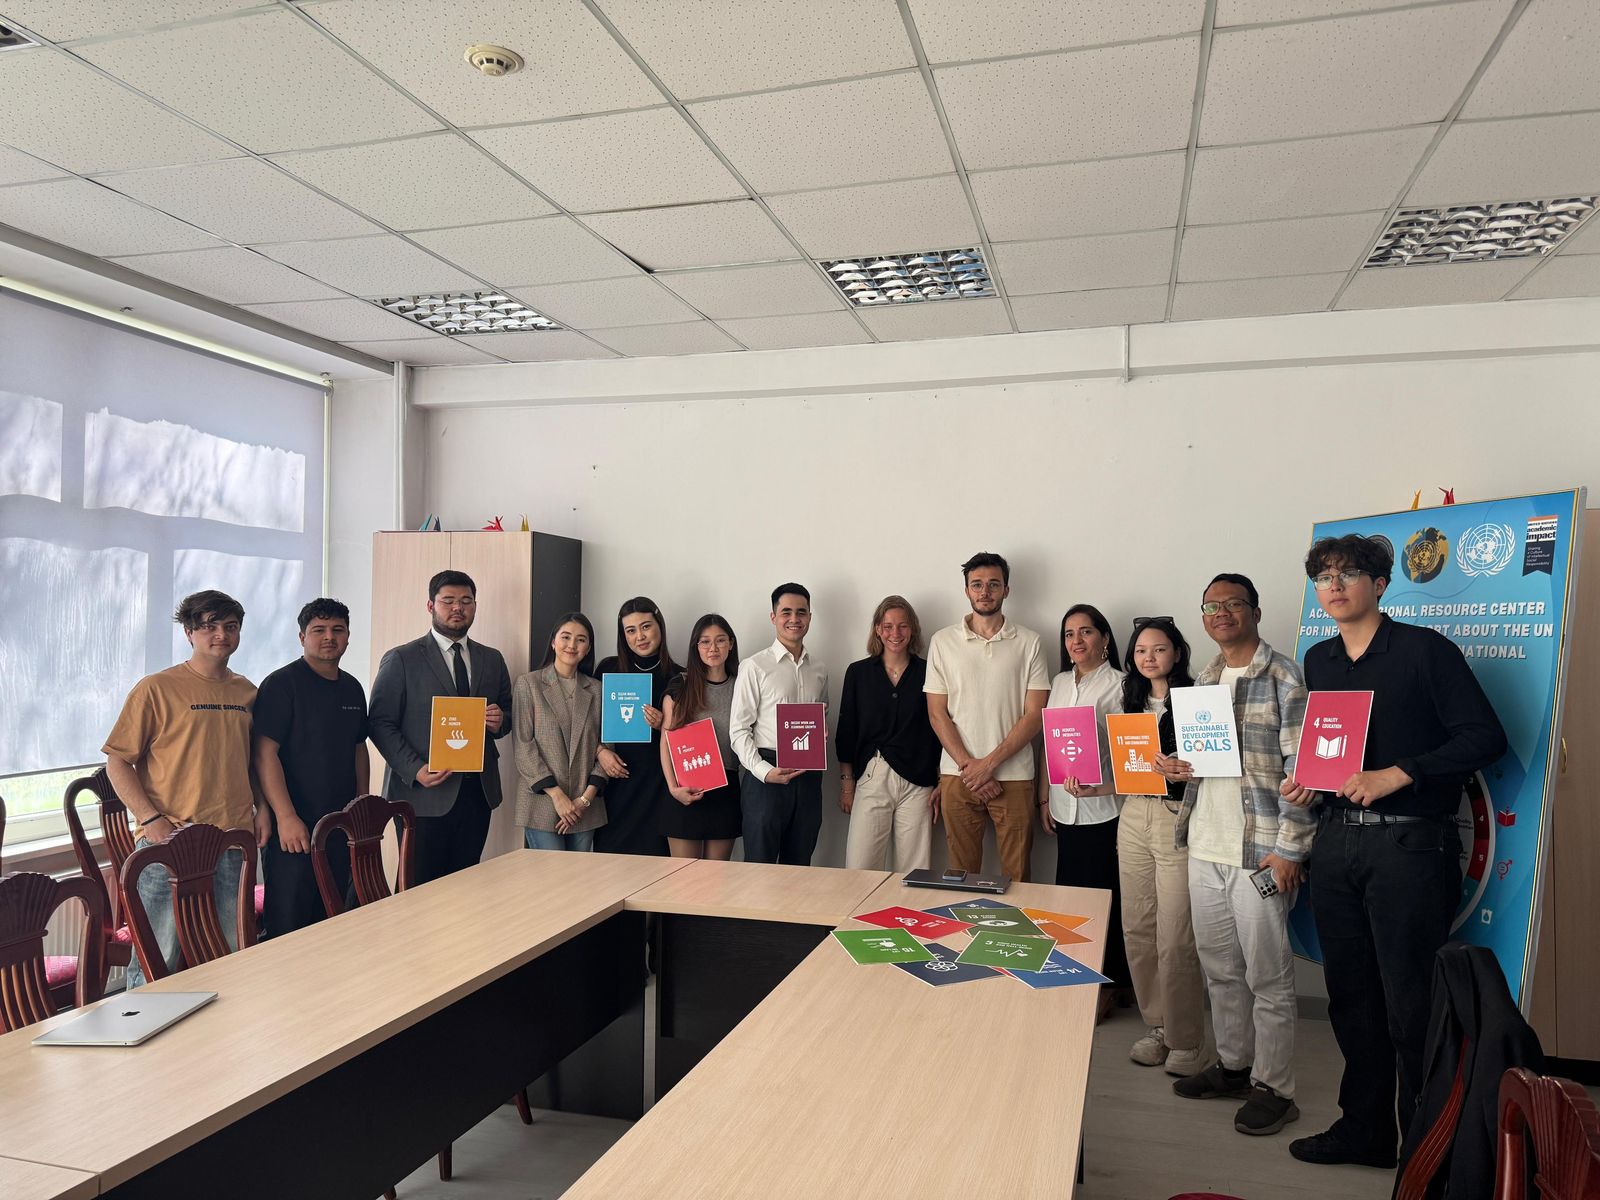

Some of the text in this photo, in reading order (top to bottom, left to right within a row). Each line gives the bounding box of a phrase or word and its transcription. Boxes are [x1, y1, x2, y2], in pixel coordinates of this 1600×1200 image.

[1526, 531, 1556, 542] impact
[1420, 603, 1487, 617] RESOURCE
[1490, 601, 1545, 615] CENTER
[1299, 625, 1319, 637] FOR
[1452, 624, 1498, 637] ABOUT
[1503, 624, 1530, 637] THE
[1533, 623, 1554, 637] UN
[611, 692, 616, 700] 6
[441, 716, 447, 726] 2
[784, 721, 789, 729] 8
[1313, 717, 1320, 728] 4
[1052, 728, 1060, 737] 10
[1181, 724, 1229, 732] SUSTAINABLE
[1117, 736, 1123, 745] 11
[1183, 738, 1232, 752] GOALS
